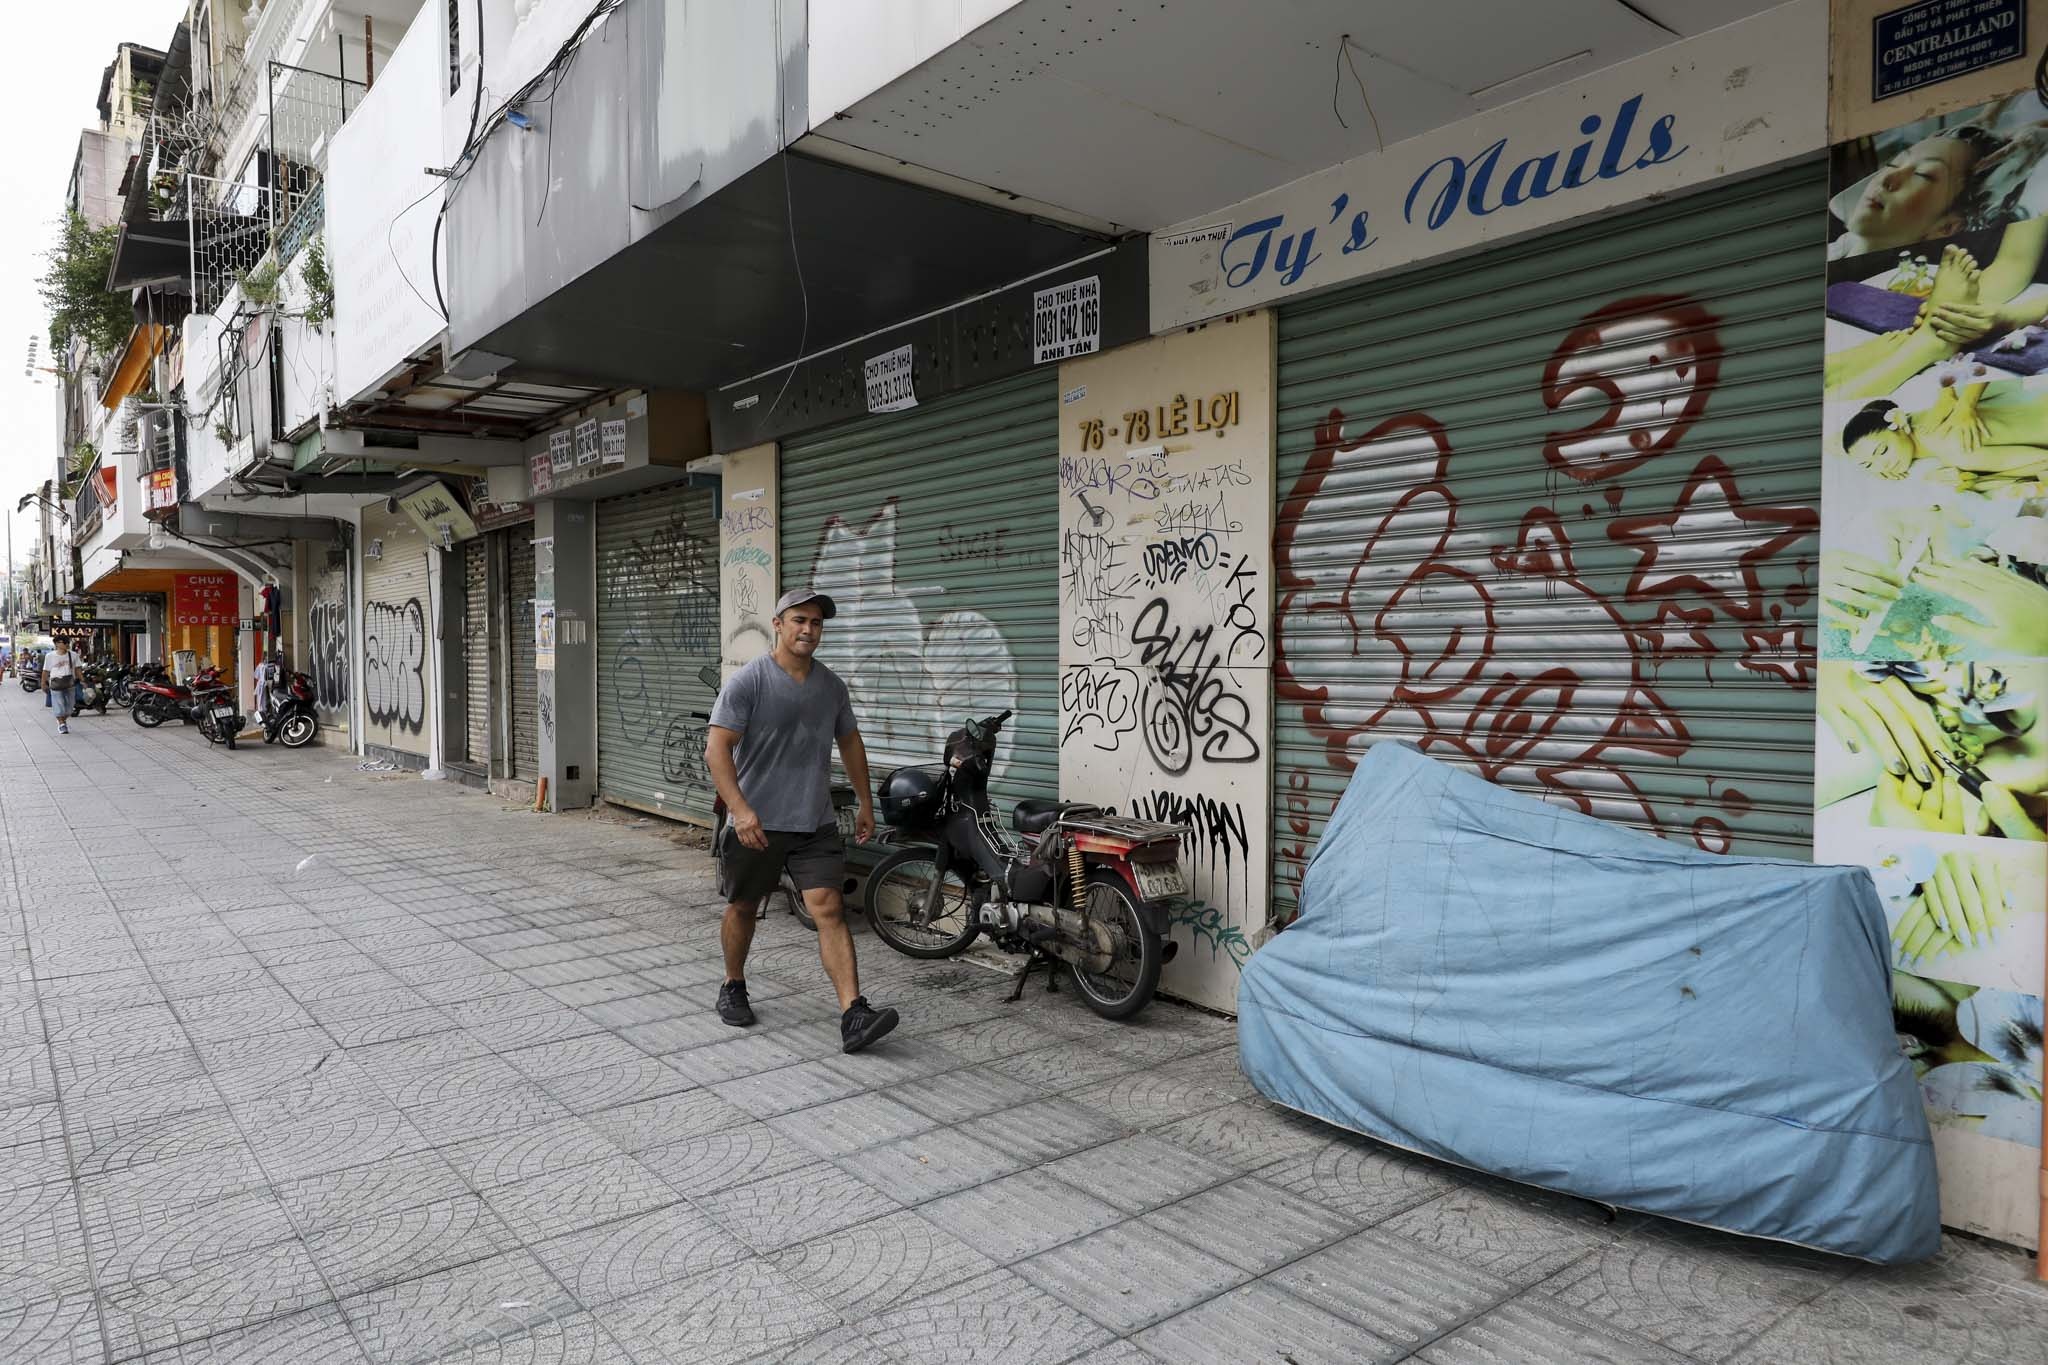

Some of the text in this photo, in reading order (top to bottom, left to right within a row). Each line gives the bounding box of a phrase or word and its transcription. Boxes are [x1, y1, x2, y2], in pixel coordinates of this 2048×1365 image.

[1902, 9, 1927, 25] CÔNG
[1930, 4, 1942, 15] TY
[1931, 15, 1943, 28] VÀ
[1945, 8, 1971, 24] PHÁT
[1882, 10, 2015, 66] CENTRALLAND
[1220, 93, 1690, 288] Ty's Nails
[1207, 226, 1228, 242] THUÊ
[1037, 279, 1097, 310] CHO THUÊ NHÀ
[1035, 308, 1058, 348] 0931
[1060, 303, 1078, 342] 642
[1081, 297, 1099, 338] 166
[1041, 340, 1093, 361] ANH TÂN
[865, 346, 912, 381] CHO THUÊ NHÀ
[1079, 419, 1105, 451] 76
[1122, 409, 1151, 444] 78
[1156, 393, 1189, 439] LÊ
[1193, 391, 1240, 438] LỢI
[189, 575, 225, 585] CHUK
[192, 589, 221, 598] TEA
[177, 615, 240, 624] COFFEE
